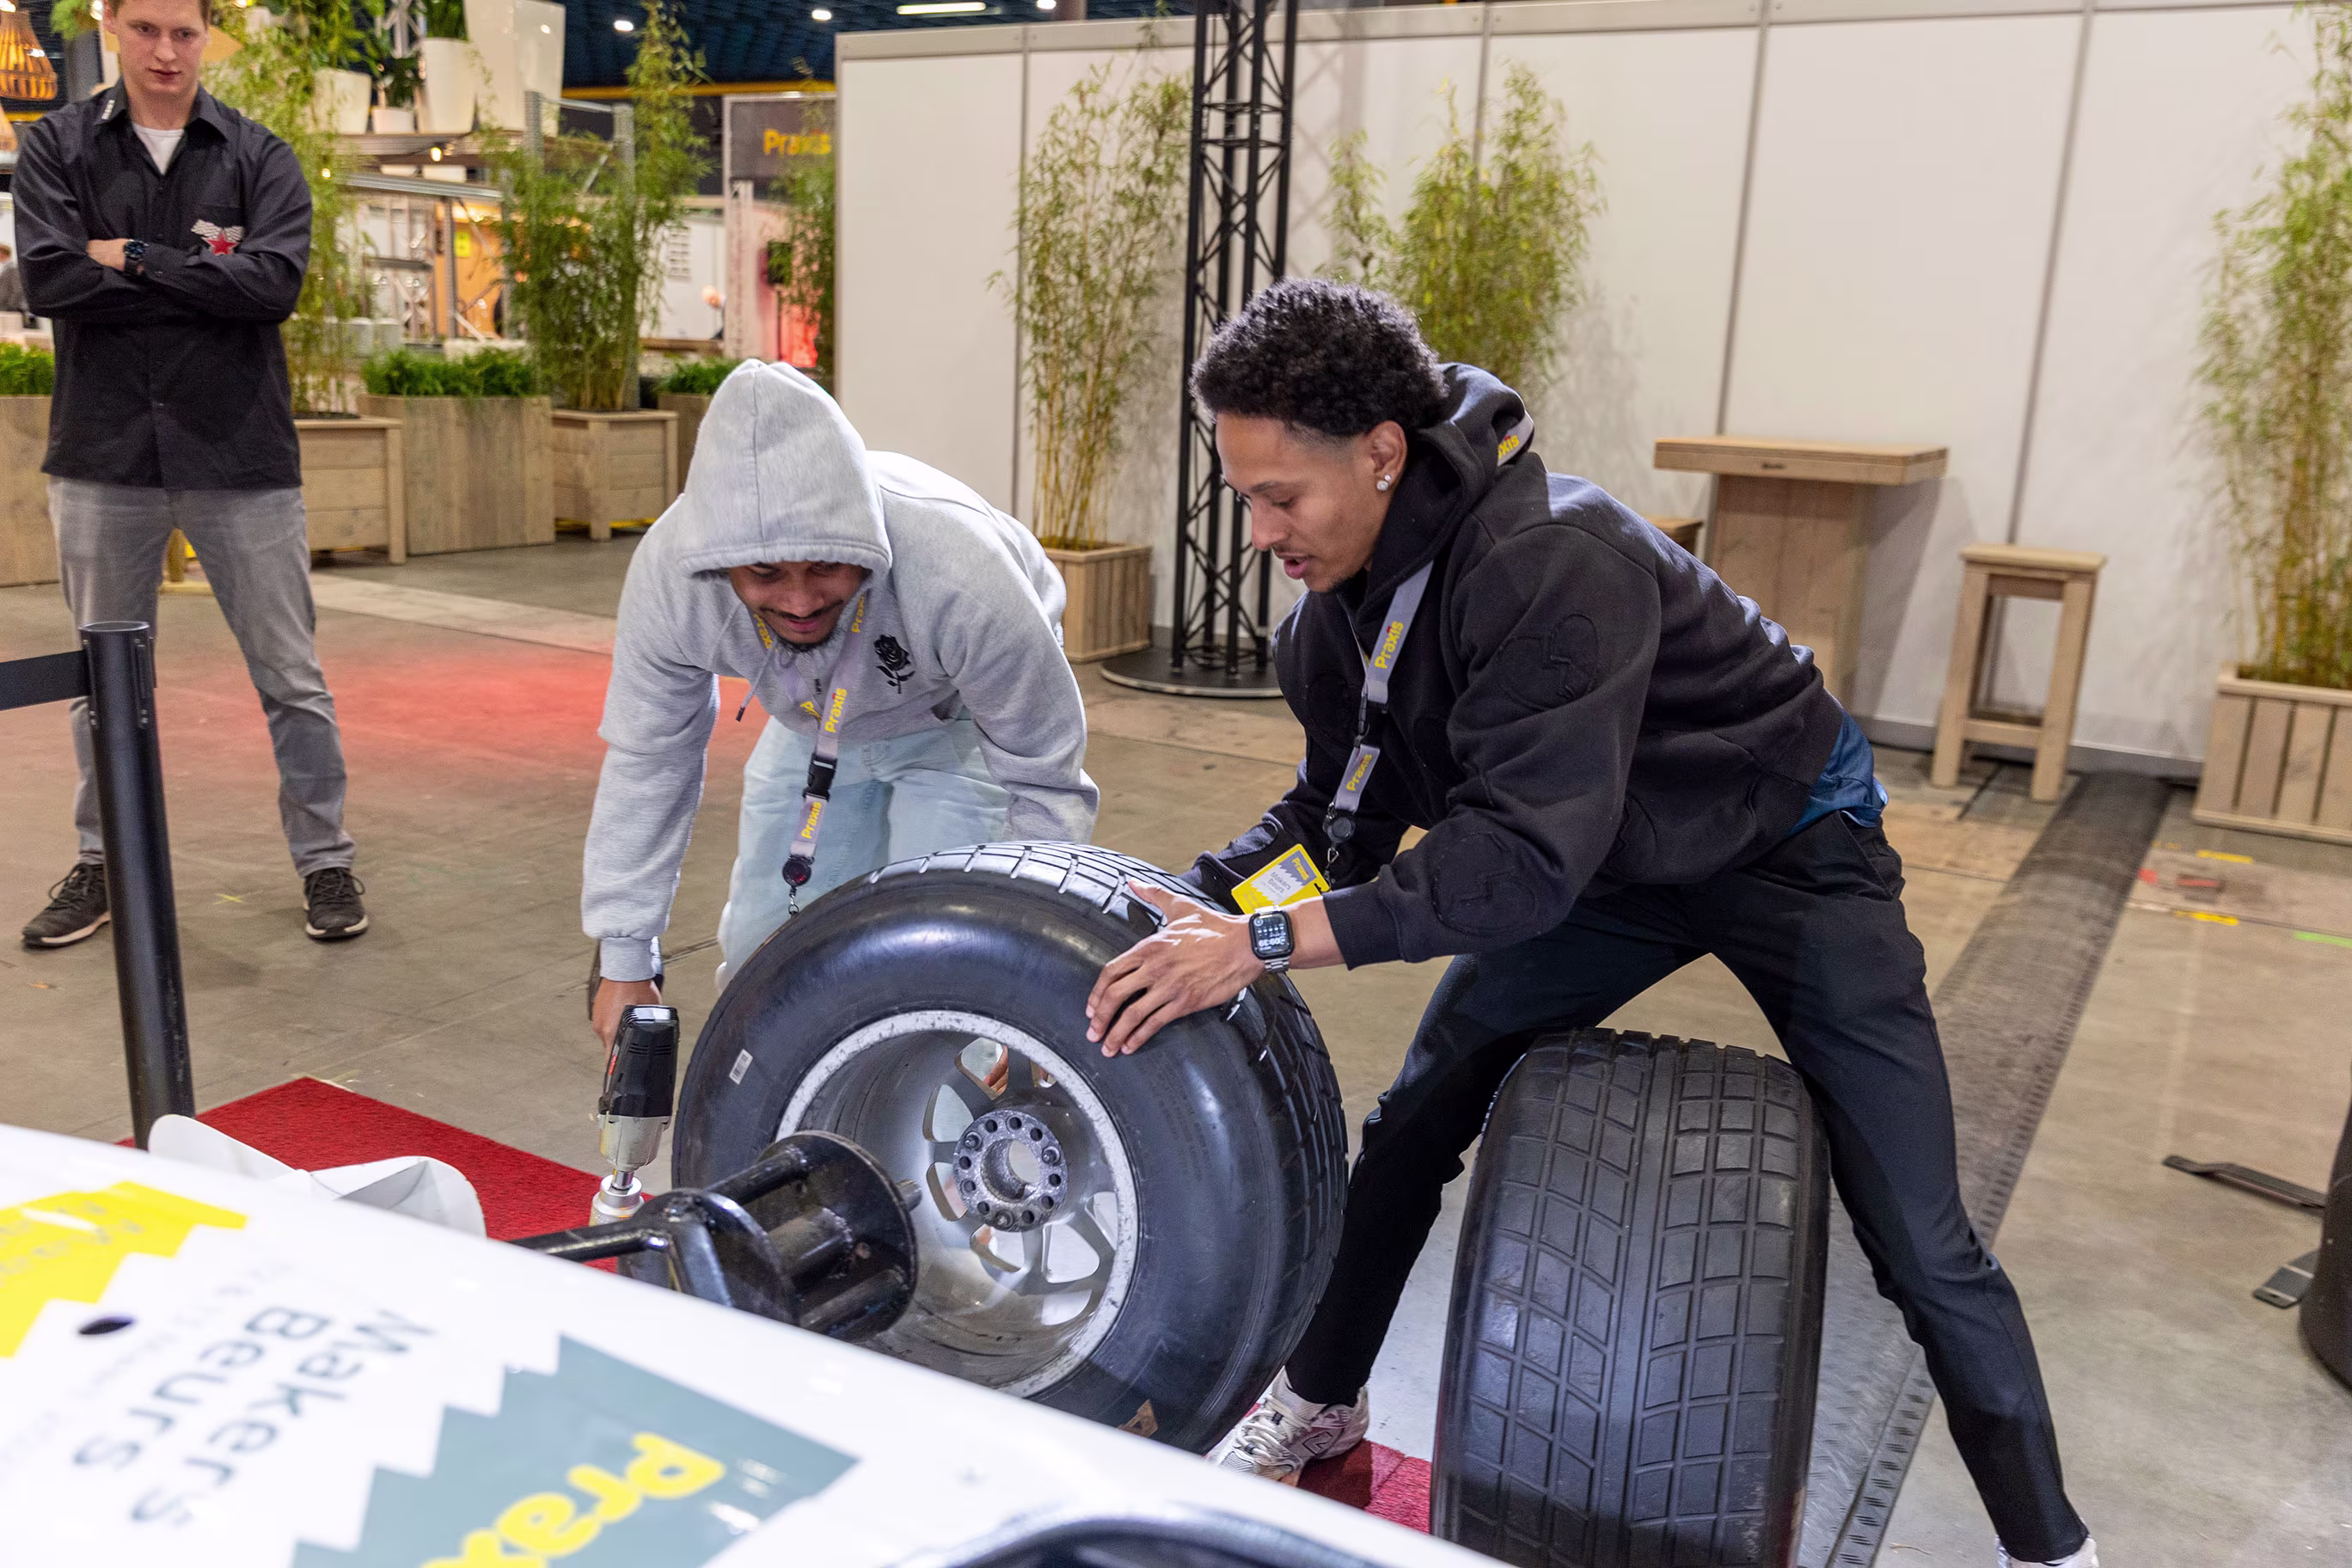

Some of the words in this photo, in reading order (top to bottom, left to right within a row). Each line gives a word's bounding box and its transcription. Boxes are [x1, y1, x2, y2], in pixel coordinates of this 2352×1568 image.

[1375, 621, 1404, 669] Praxis
[824, 688, 848, 732] Praxis
[1346, 754, 1373, 792] Praxis
[801, 801, 822, 839] Praxis
[1292, 857, 1309, 881] Praxis
[73, 1306, 333, 1471] Beurs
[129, 1309, 437, 1527] Makers
